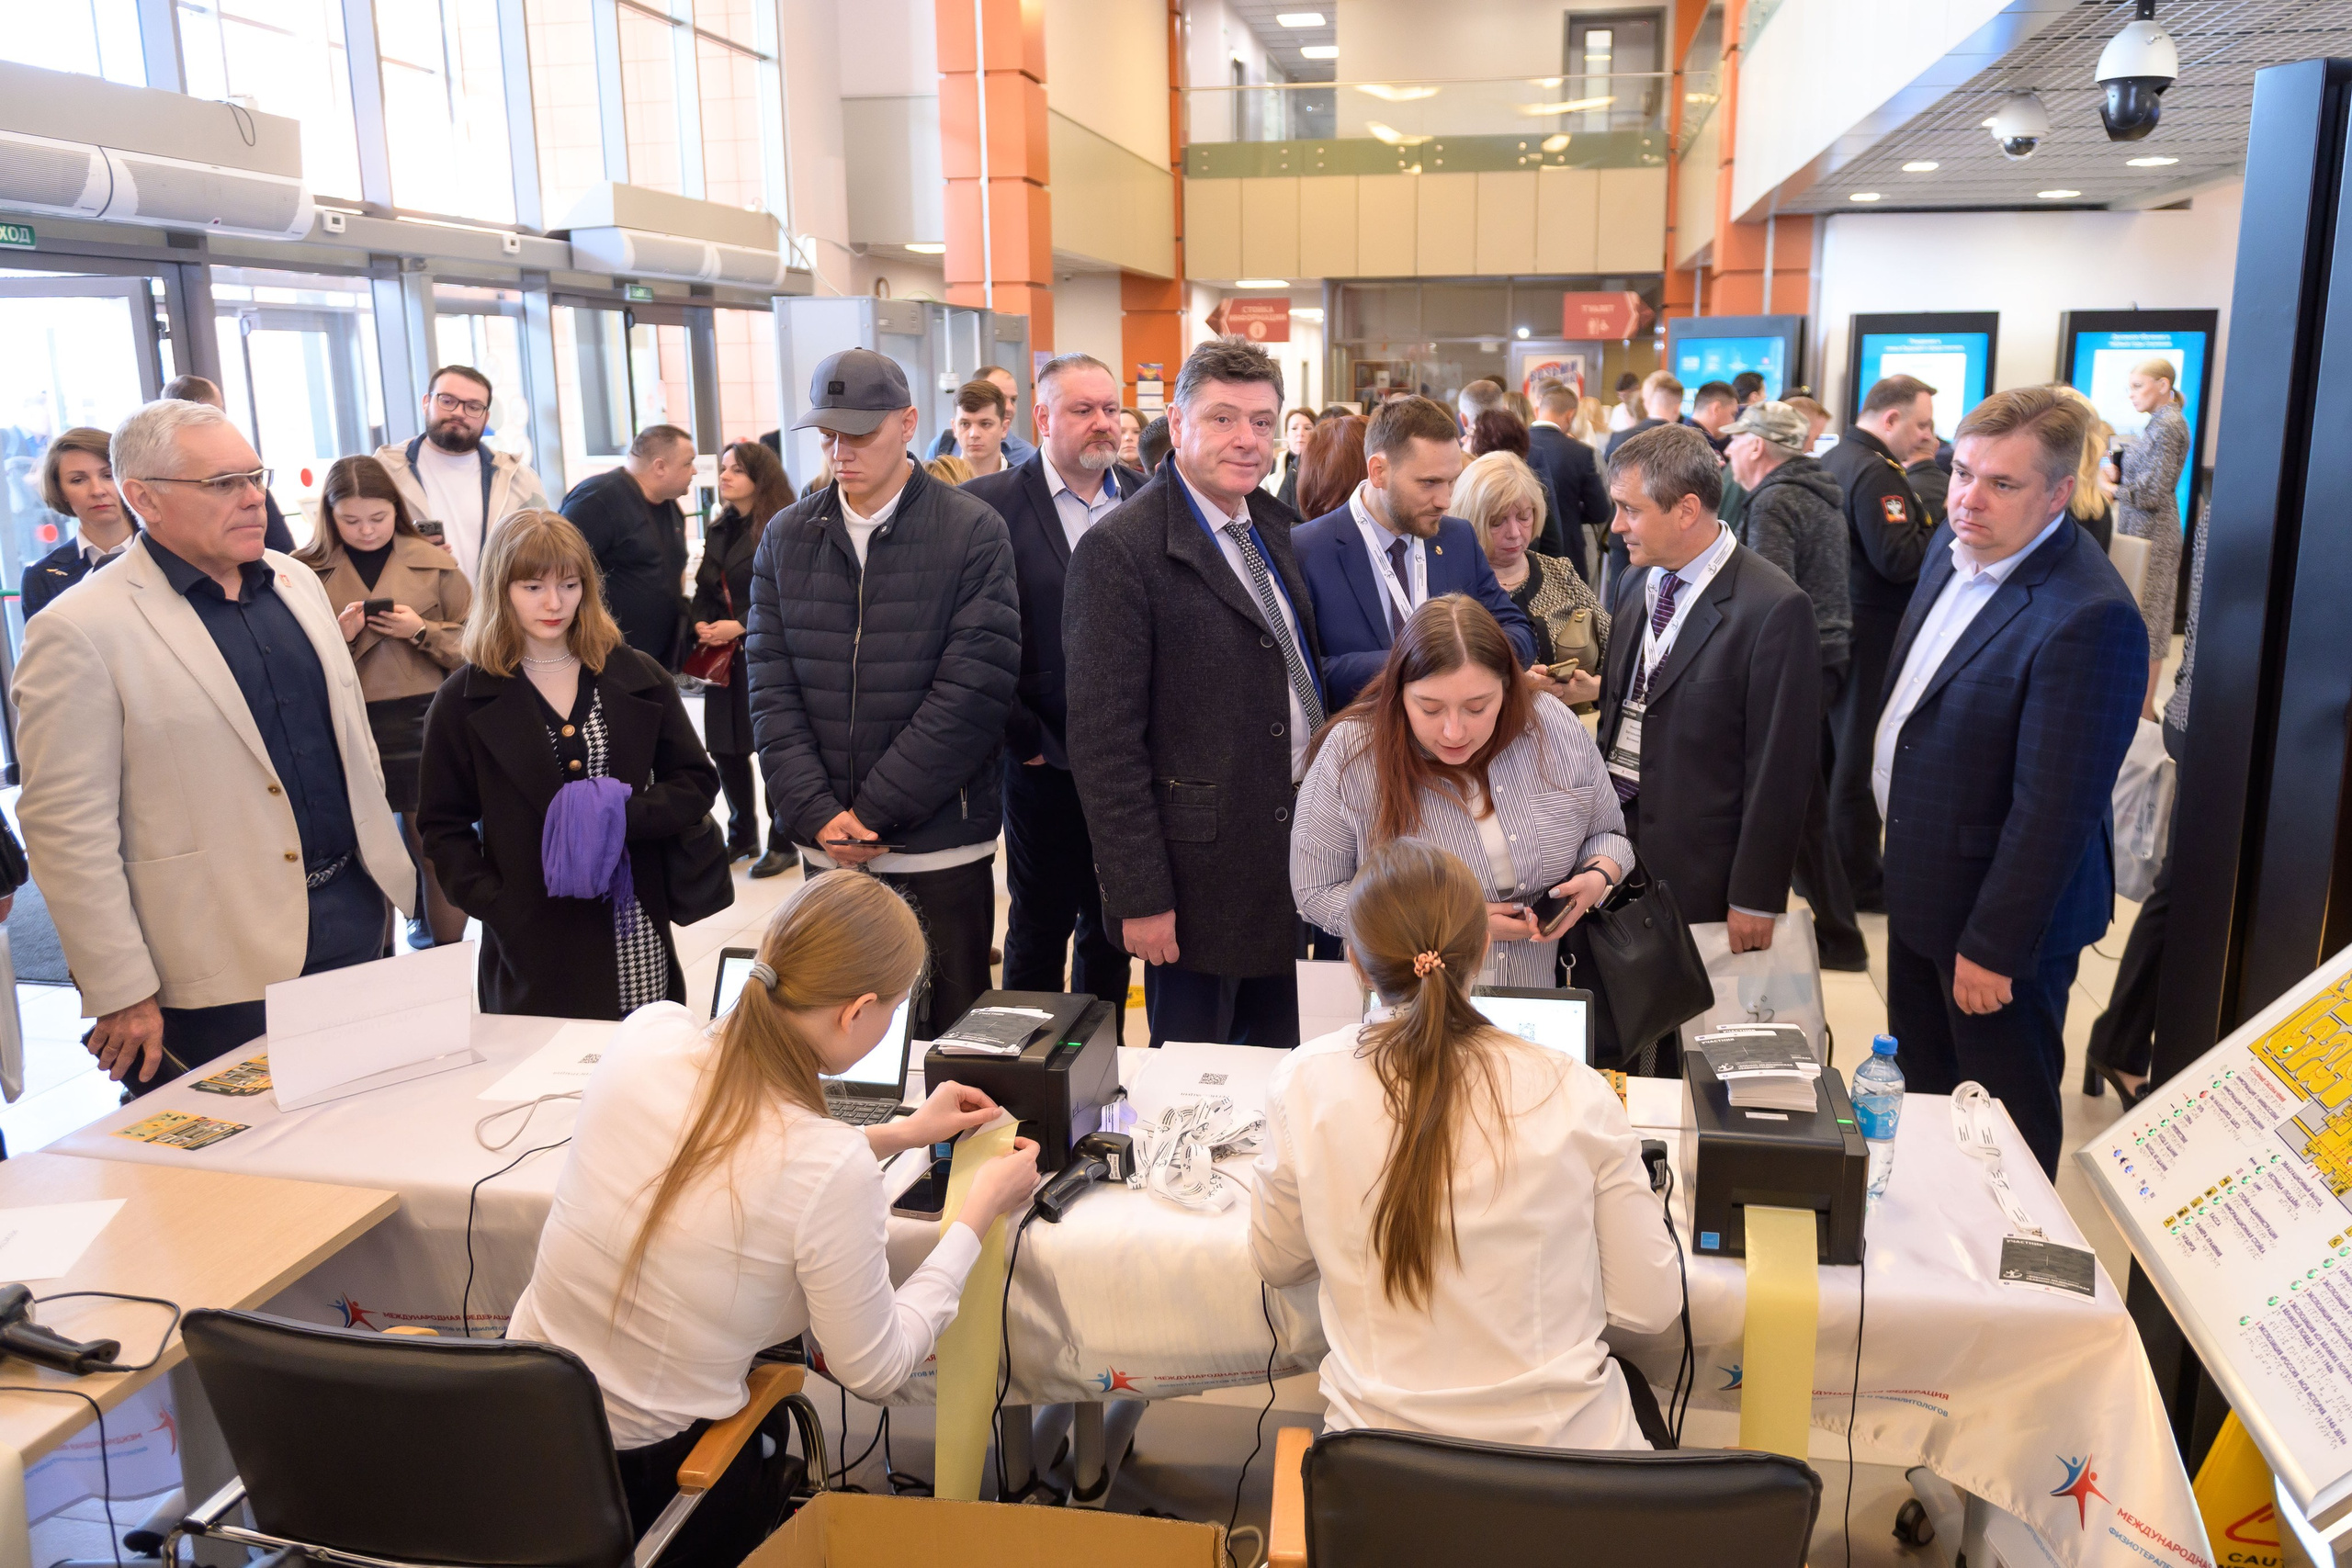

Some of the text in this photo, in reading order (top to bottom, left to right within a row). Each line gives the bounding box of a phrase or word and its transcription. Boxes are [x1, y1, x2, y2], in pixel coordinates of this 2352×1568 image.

[0, 225, 30, 243] ХОД
[2267, 1171, 2284, 1190] ЛЕСТНИЦА
[2309, 1191, 2324, 1207] ВЫХОД
[2209, 1212, 2222, 1226] КАССА
[2194, 1223, 2208, 1238] КАМЕРА
[2007, 1239, 2043, 1247] УЧАСТНИК
[2179, 1232, 2196, 1252] ГАРДЕРОБ
[2250, 1235, 2267, 1254] СТОЙКА
[2322, 1279, 2349, 1310] ЭКСПОЗИЦИЯ
[2306, 1290, 2333, 1322] ЭКСПОЗИЦИЯ
[382, 1312, 460, 1321] МЕЖДУНАРОДНАЯ
[2282, 1306, 2302, 1329] ВЕЛИКОЙ
[2290, 1302, 2316, 1333] ЭКСПОЗИЦИЯ
[2320, 1340, 2339, 1362] ВЕЛИКИХ
[2336, 1360, 2352, 1383] ПОТРЯС
[2257, 1324, 2283, 1356] ЭКСПОЗИЦИЯ
[2297, 1378, 2310, 1392] МОЯ
[1153, 1371, 1238, 1381] МЕЖДУНАРОДНАЯ
[1886, 1389, 1949, 1401] ФЕДЕРАЦИЯ
[2109, 1527, 2176, 1568] ФИЗИОТЕРАПЕ
